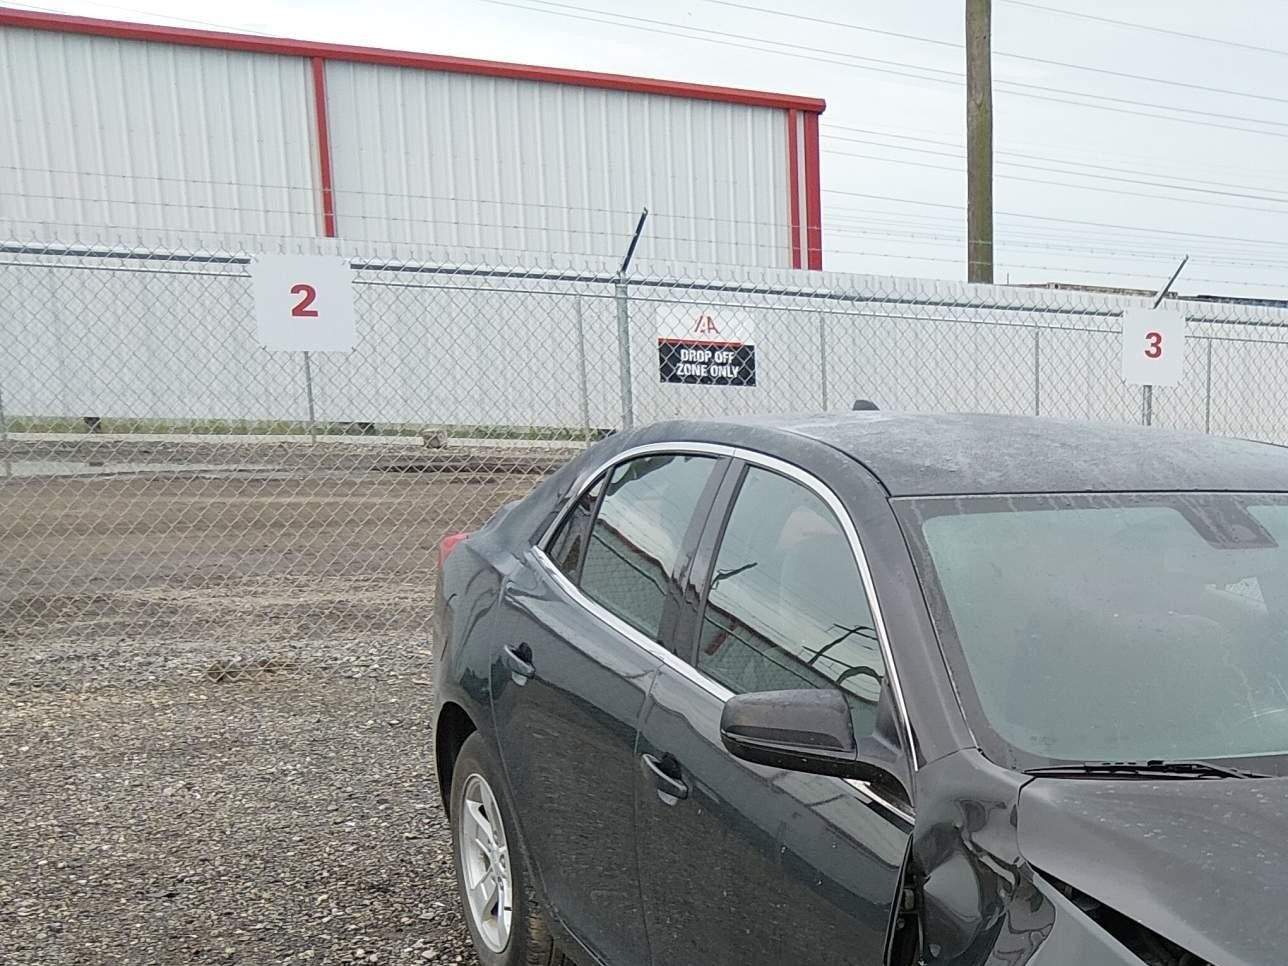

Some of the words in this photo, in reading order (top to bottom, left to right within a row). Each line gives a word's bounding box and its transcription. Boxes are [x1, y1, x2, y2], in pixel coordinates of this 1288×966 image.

[290, 284, 318, 317] 2
[1144, 331, 1162, 359] 3
[680, 349, 712, 363] DROP
[714, 350, 735, 364] OFF
[676, 363, 708, 377] ZONE
[710, 365, 740, 378] ONLY
